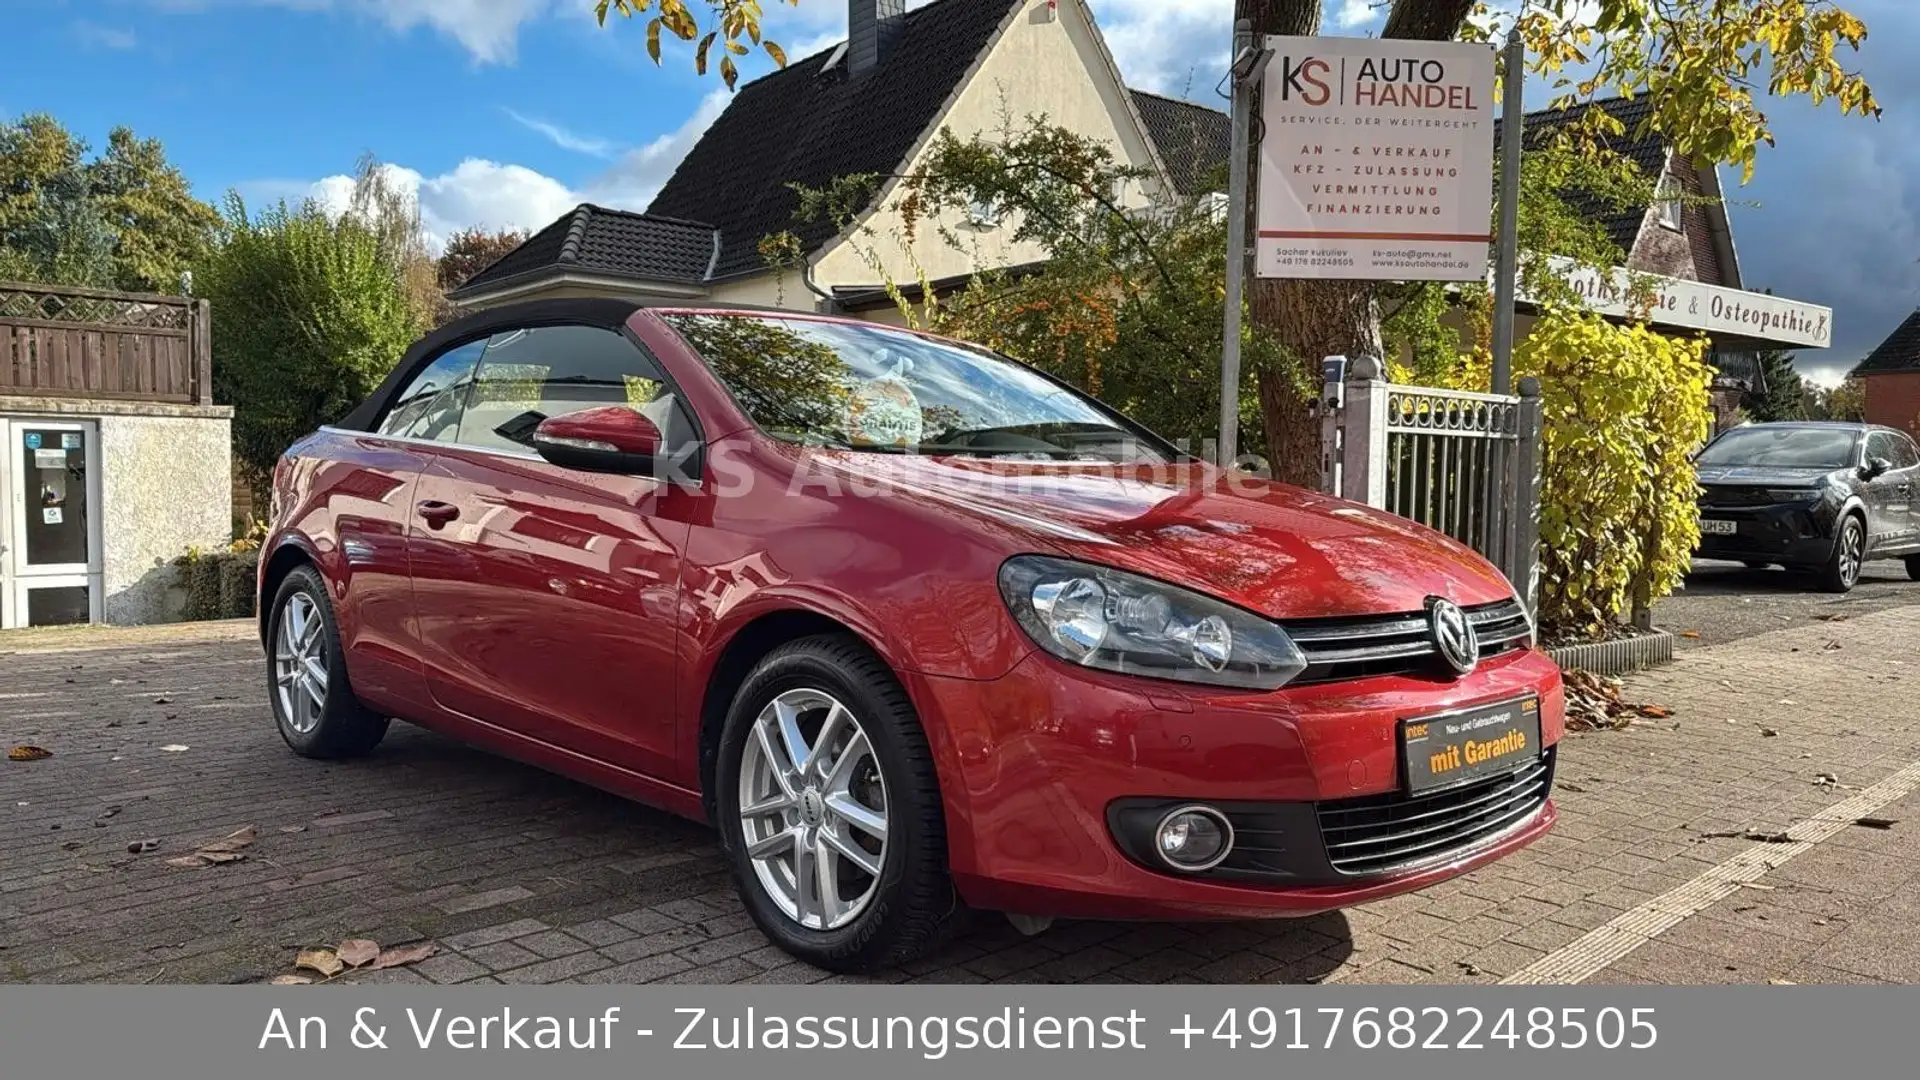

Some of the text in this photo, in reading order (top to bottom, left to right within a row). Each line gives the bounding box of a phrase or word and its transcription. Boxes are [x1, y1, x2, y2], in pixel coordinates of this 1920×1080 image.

[1357, 57, 1444, 83] AUTO
[1282, 56, 1331, 106] KS
[1355, 82, 1478, 110] HANDEL
[1355, 117, 1381, 126] DER
[1389, 118, 1479, 129] WEITERGEHT
[1301, 145, 1323, 155] AN
[1353, 147, 1360, 155] &
[1373, 147, 1452, 159] VERKAUF
[1294, 164, 1325, 174] KFZ
[1354, 166, 1457, 178] ZULASSUNG
[1312, 184, 1438, 196] VERMITTLUNG
[1307, 203, 1441, 216] FINANZIERUNG
[1688, 300, 1698, 315] &
[1712, 295, 1812, 334] Osteopathie
[1719, 521, 1732, 531] 53
[1431, 728, 1525, 773] mit Garantie
